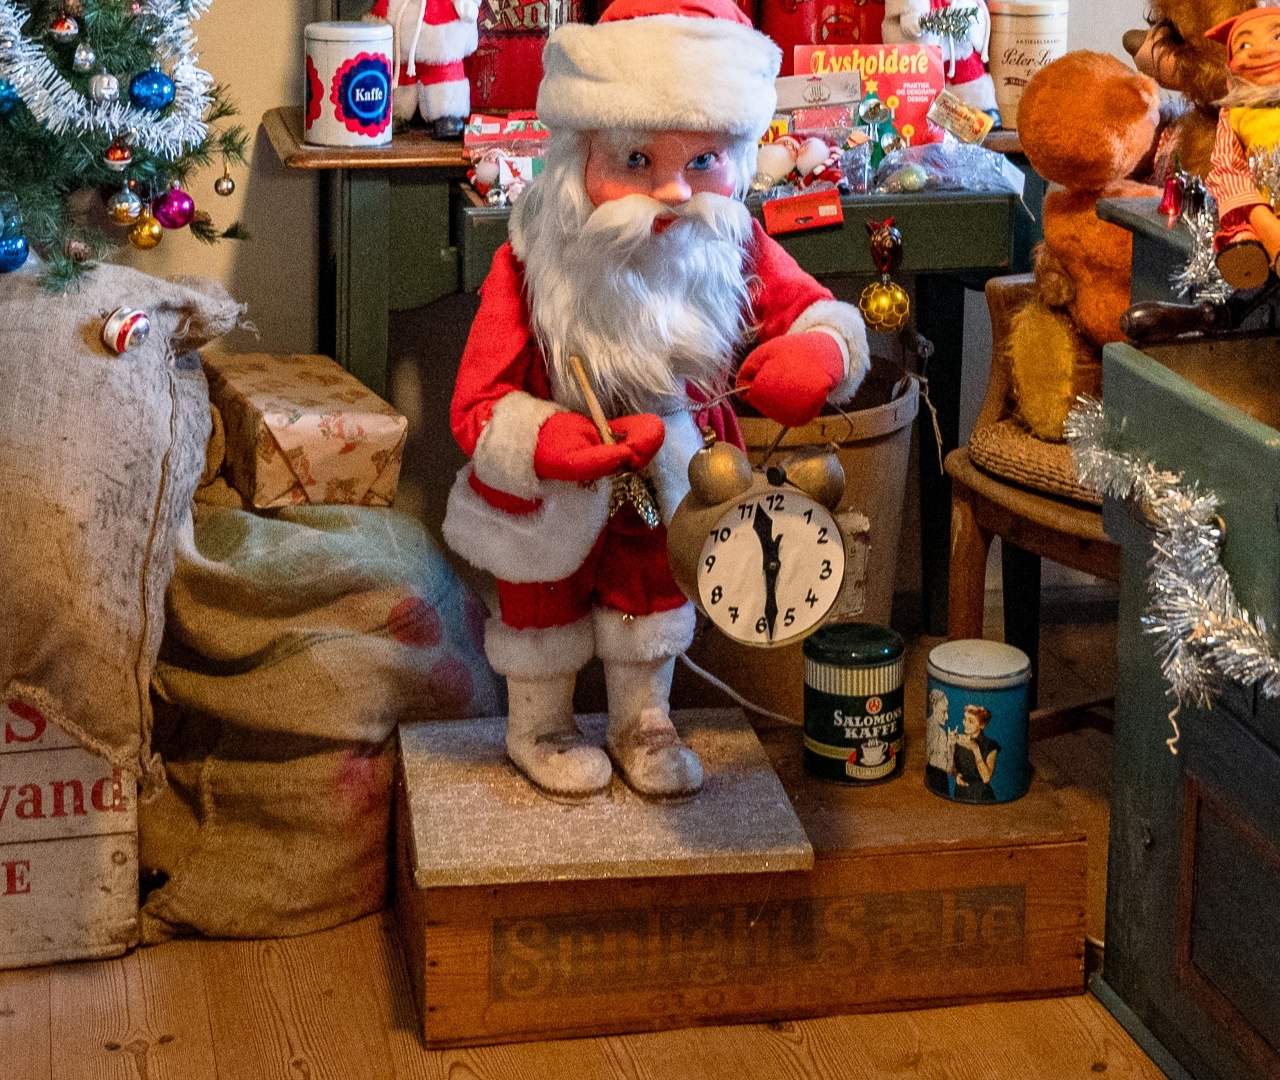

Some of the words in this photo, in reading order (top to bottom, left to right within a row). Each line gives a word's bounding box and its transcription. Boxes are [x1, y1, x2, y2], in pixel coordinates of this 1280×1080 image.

[810, 48, 929, 80] Lysholdere
[354, 87, 383, 102] Kaffe
[738, 503, 755, 520] 11
[766, 494, 785, 512] 12
[803, 508, 814, 525] 1
[710, 527, 732, 545] 10
[816, 527, 830, 545] 2
[704, 554, 717, 574] 9
[819, 559, 833, 581] 3
[710, 585, 724, 605] 8
[804, 587, 819, 608] 4
[727, 606, 740, 625] 7
[755, 616, 768, 634] 6
[783, 607, 796, 628] 5
[844, 721, 899, 745] KAFFE
